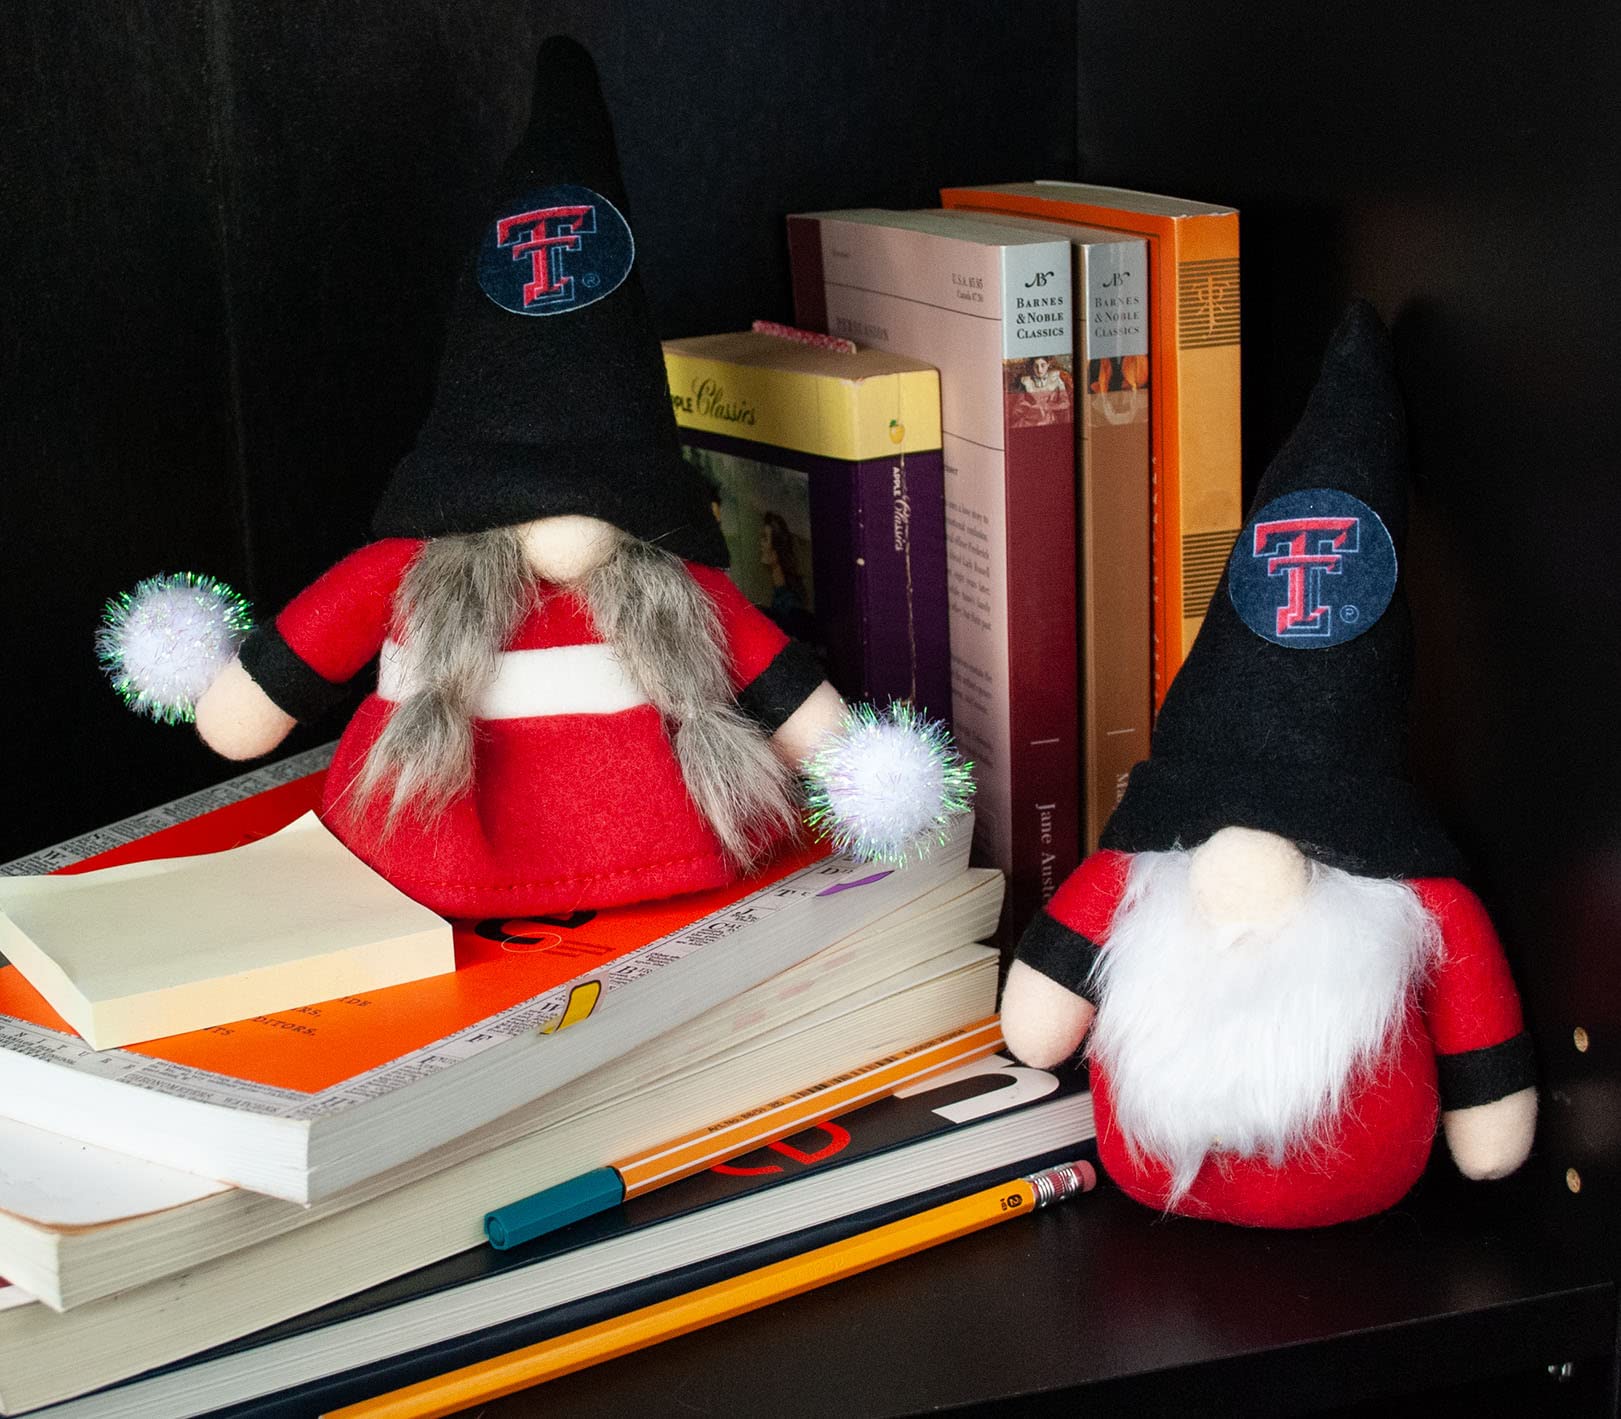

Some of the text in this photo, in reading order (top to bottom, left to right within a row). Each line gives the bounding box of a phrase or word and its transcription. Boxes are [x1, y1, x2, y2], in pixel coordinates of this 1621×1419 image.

[1016, 296, 1064, 309] BARNES
[1016, 312, 1064, 325] & NOBLE
[1016, 327, 1065, 340] CLASSICS
[691, 376, 756, 426] Classics
[1034, 802, 1056, 845] Jane
